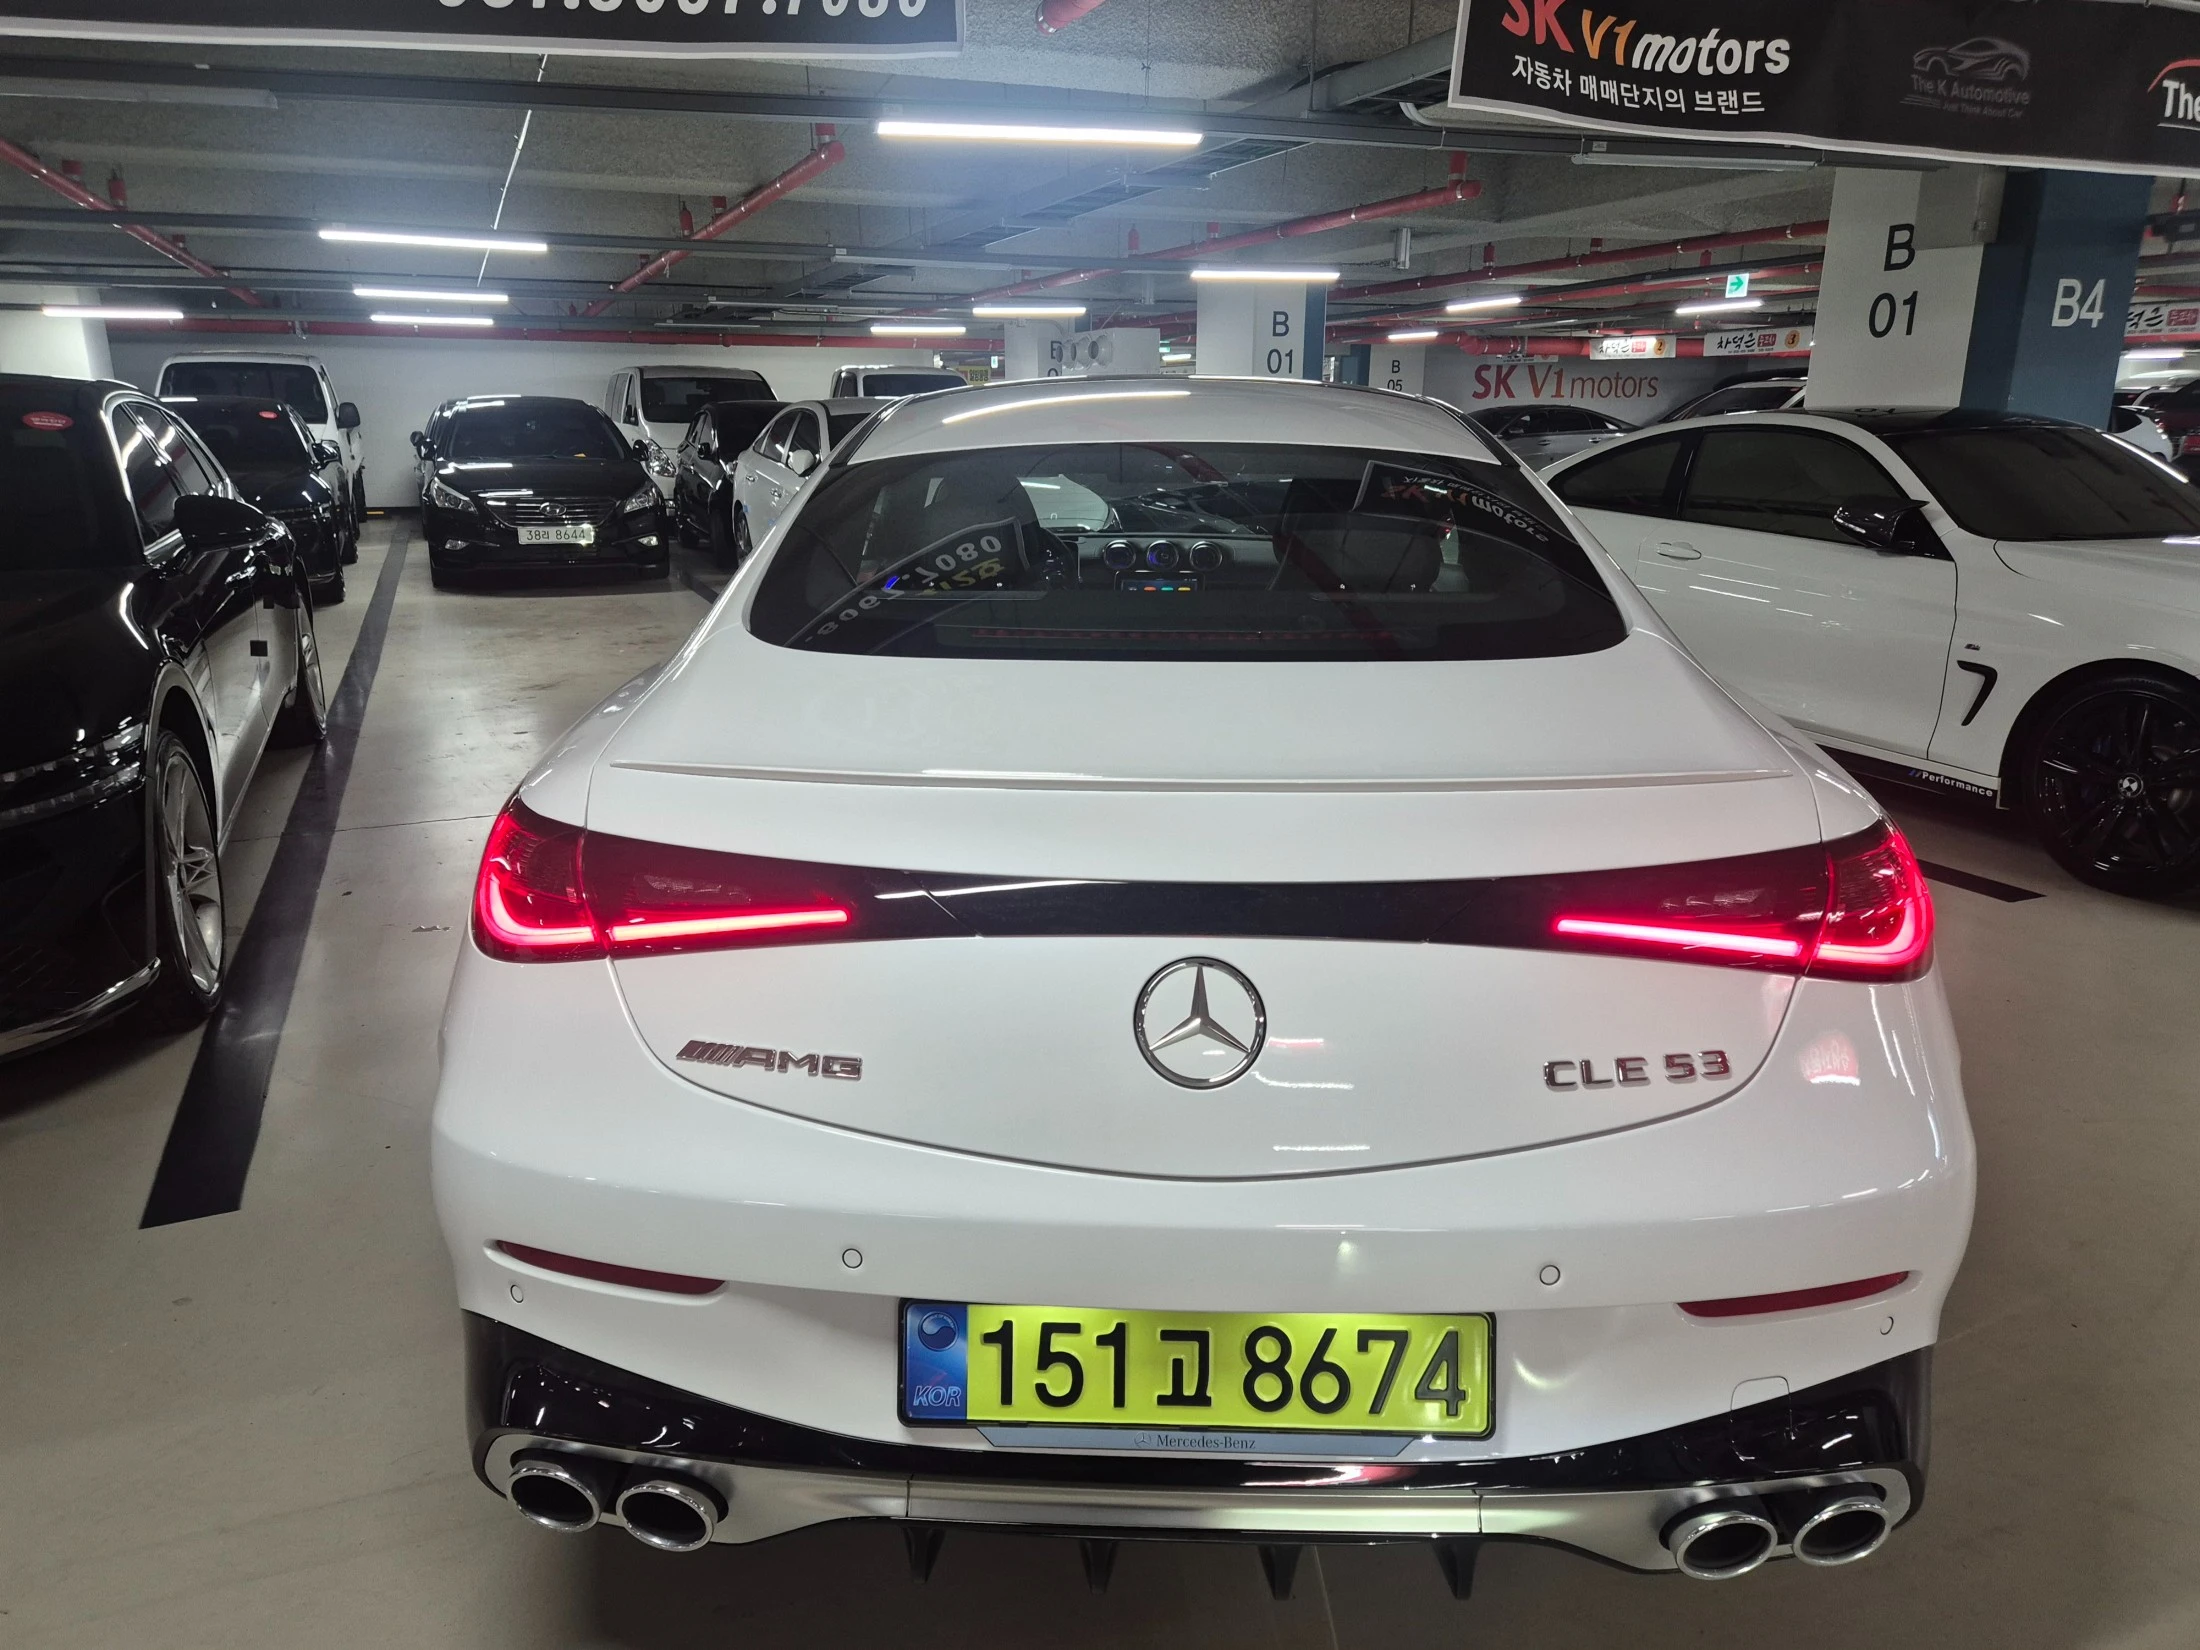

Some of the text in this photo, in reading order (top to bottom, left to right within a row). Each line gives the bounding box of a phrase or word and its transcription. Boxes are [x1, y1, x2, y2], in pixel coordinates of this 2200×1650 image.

[1501, 0, 1575, 53] SK
[1512, 54, 1765, 114] 자동차 매매단지의 브랜드
[1911, 74, 2030, 105] The K Automotive
[1884, 223, 1916, 271] B
[1868, 291, 1918, 338] 01
[2051, 278, 2106, 328] B4
[1272, 311, 1289, 337] B
[1266, 349, 1294, 374] 01
[1392, 360, 1401, 373] B
[1387, 379, 1402, 391] 05
[1472, 364, 1516, 399] SK
[555, 529, 585, 540] 8644
[1922, 771, 1993, 797] Performance
[1543, 1050, 1732, 1090] CLE 53
[913, 1385, 962, 1407] KOR
[1156, 1434, 1256, 1450] Mercedes-Benz
